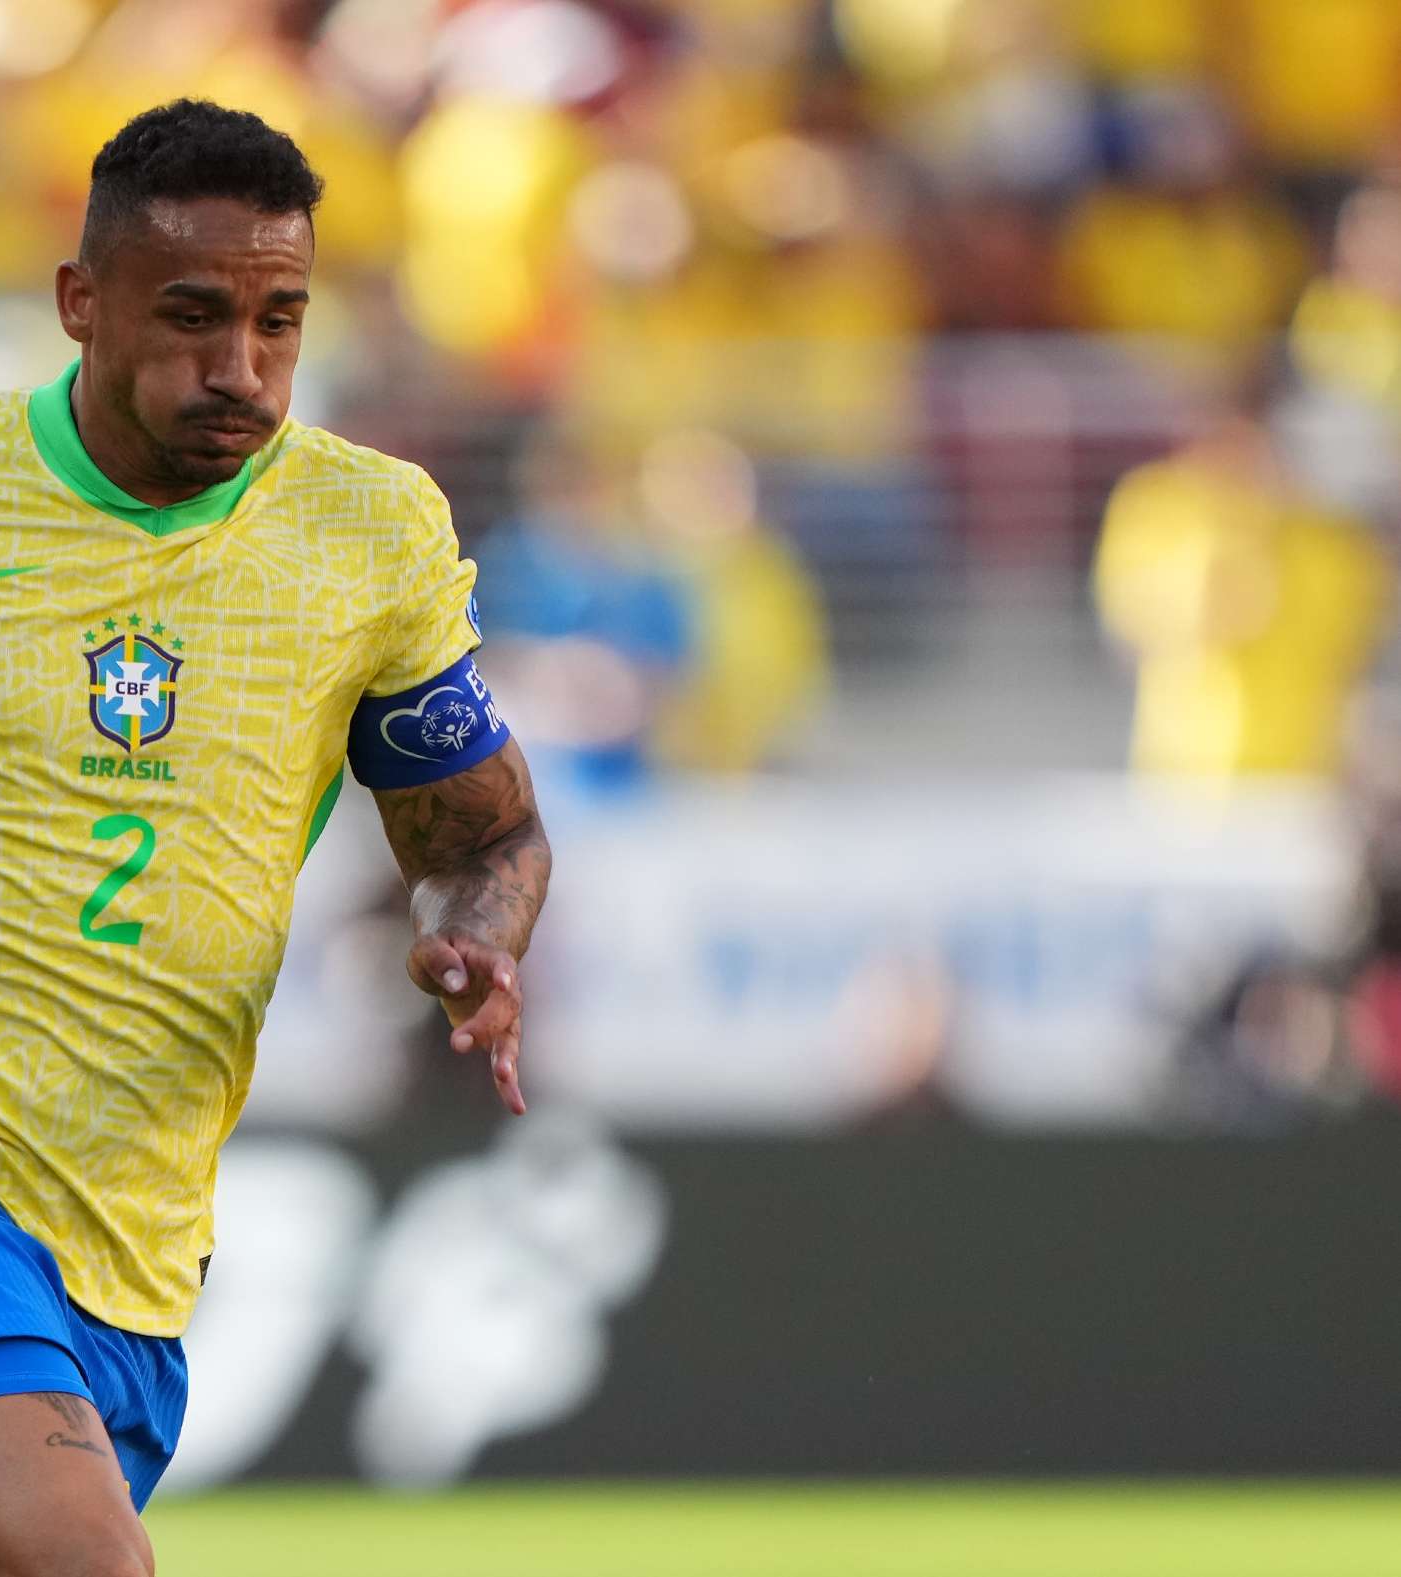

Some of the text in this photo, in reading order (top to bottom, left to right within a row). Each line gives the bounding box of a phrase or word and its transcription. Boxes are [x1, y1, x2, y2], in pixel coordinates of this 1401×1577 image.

[115, 681, 150, 696] CBF
[80, 755, 176, 782] BRASIL
[79, 813, 156, 945] 2
